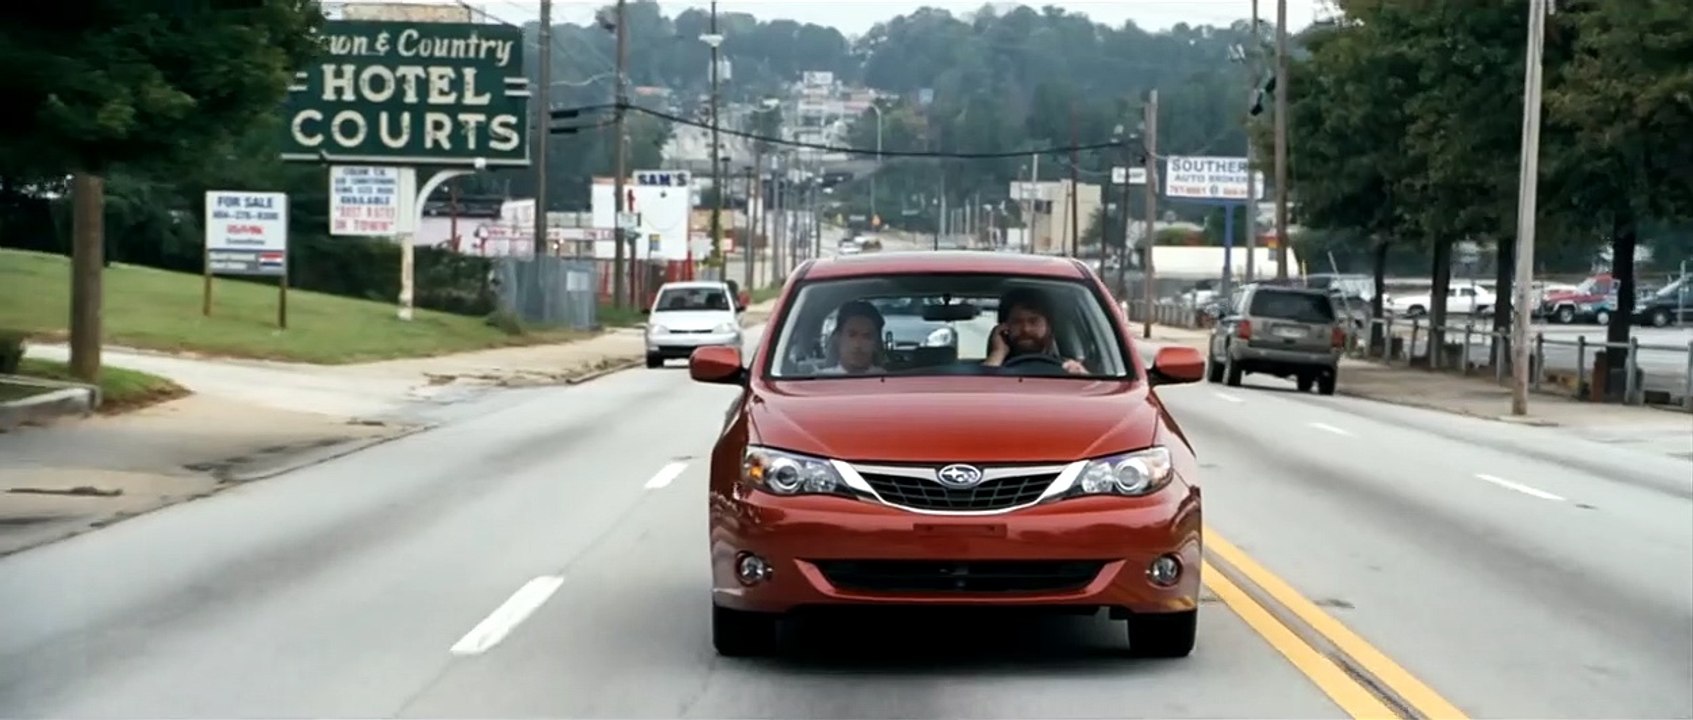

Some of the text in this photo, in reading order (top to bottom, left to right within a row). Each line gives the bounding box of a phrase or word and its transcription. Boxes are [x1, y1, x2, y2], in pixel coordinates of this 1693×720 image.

[398, 28, 514, 67] Country
[321, 63, 492, 106] HOTEL
[291, 108, 521, 151] COURTS
[1171, 158, 1248, 173] SOUTHER
[638, 174, 688, 186] SAM'S
[1174, 174, 1206, 183] AUTO
[217, 196, 273, 209] FOR SALE
[341, 196, 390, 205] AVAILABLE
